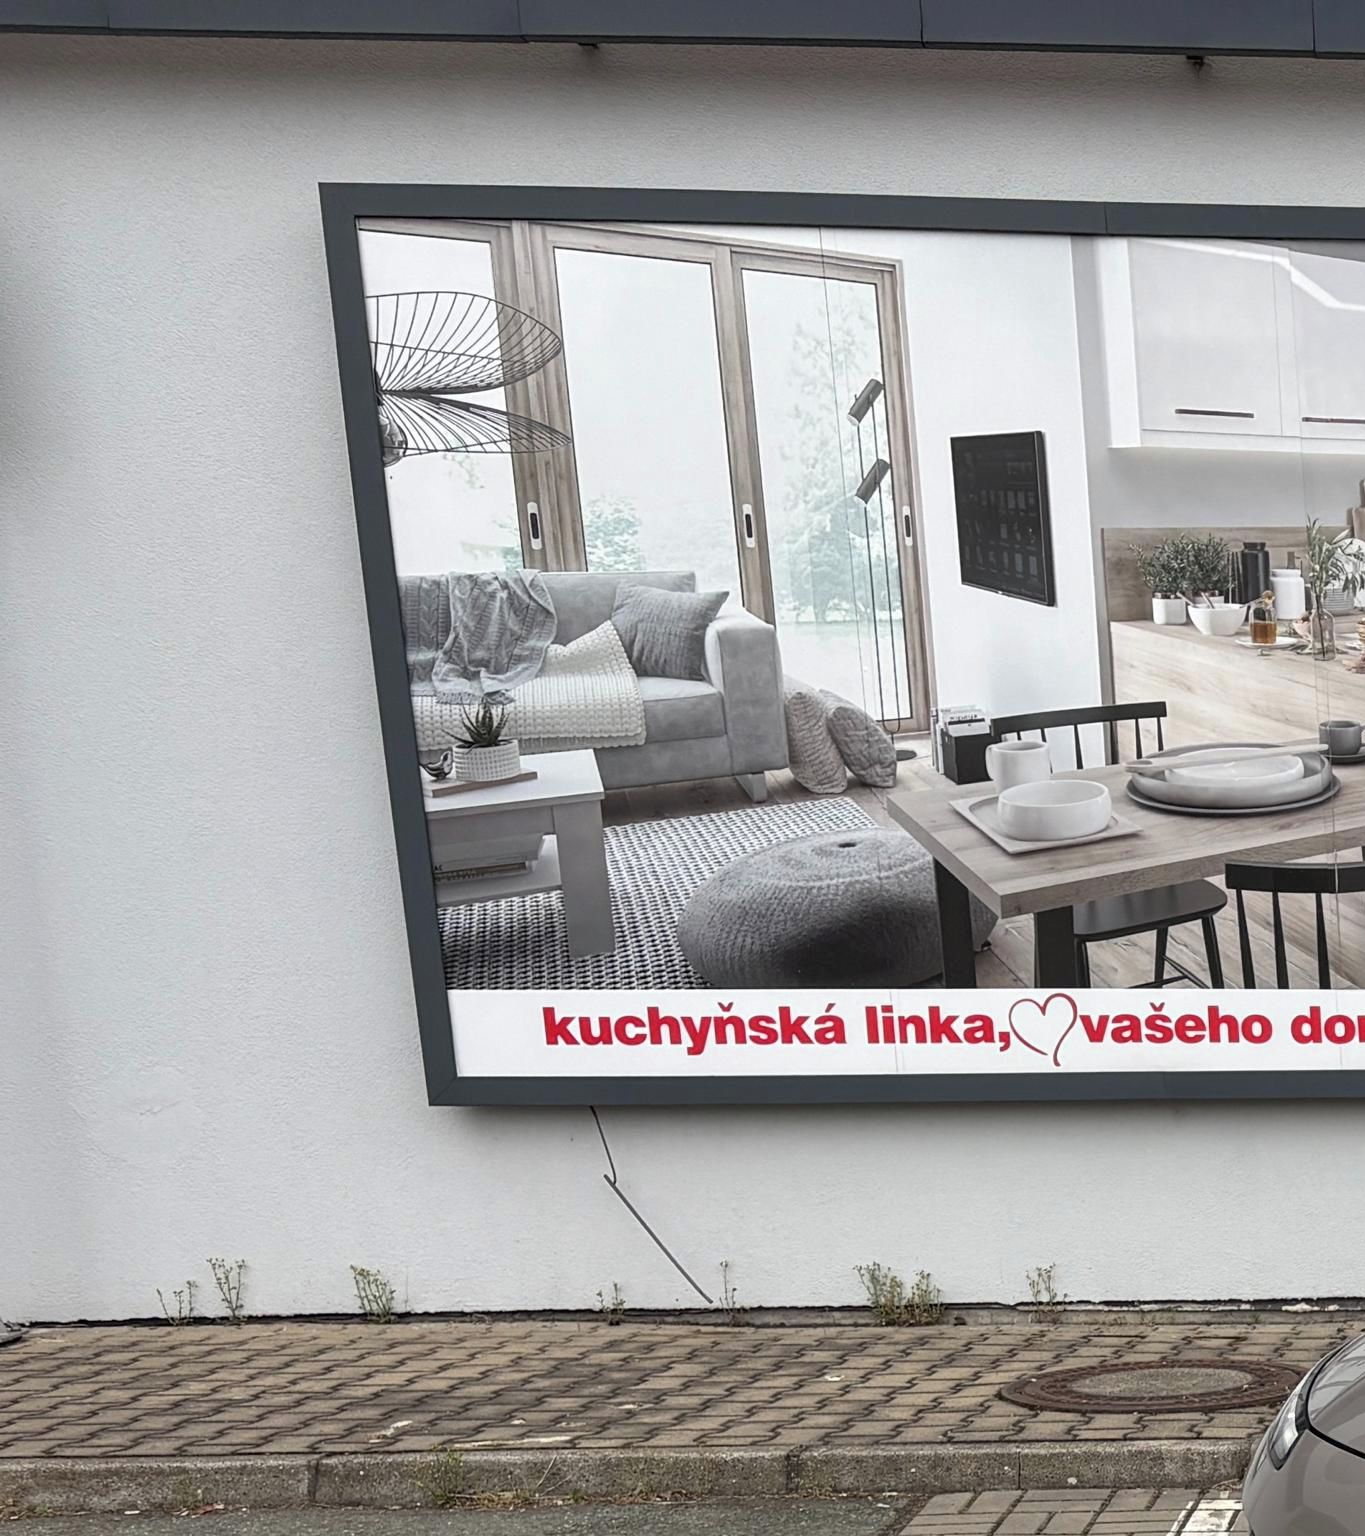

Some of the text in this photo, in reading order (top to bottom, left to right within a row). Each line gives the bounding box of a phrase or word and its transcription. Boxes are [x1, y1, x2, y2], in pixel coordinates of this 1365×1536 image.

[542, 1002, 847, 1056] kuchyňská
[865, 1005, 1011, 1053] linka,
[1079, 1002, 1274, 1045] vašeho
